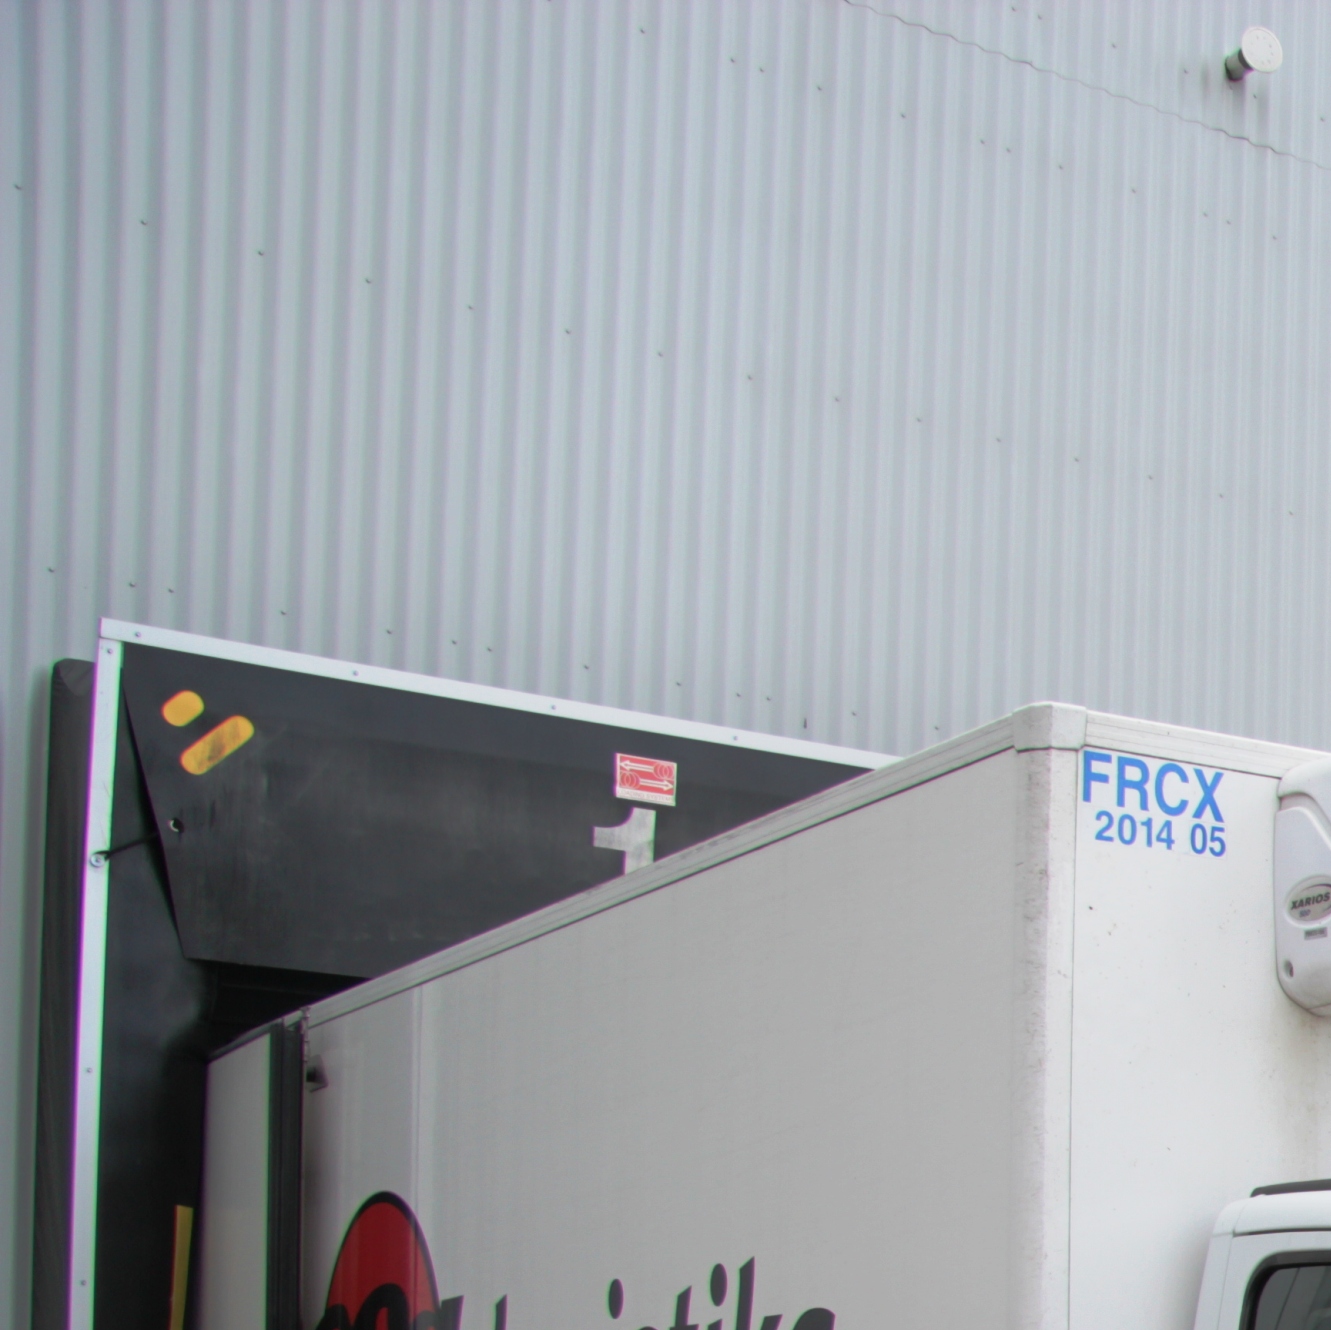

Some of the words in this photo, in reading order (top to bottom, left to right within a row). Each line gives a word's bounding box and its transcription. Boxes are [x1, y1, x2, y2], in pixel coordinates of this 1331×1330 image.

[1082, 750, 1225, 823] FRCX
[593, 807, 656, 875] 1
[1095, 810, 1175, 851] 2014
[1190, 823, 1226, 858] 05
[1290, 892, 1331, 910] XARIOS
